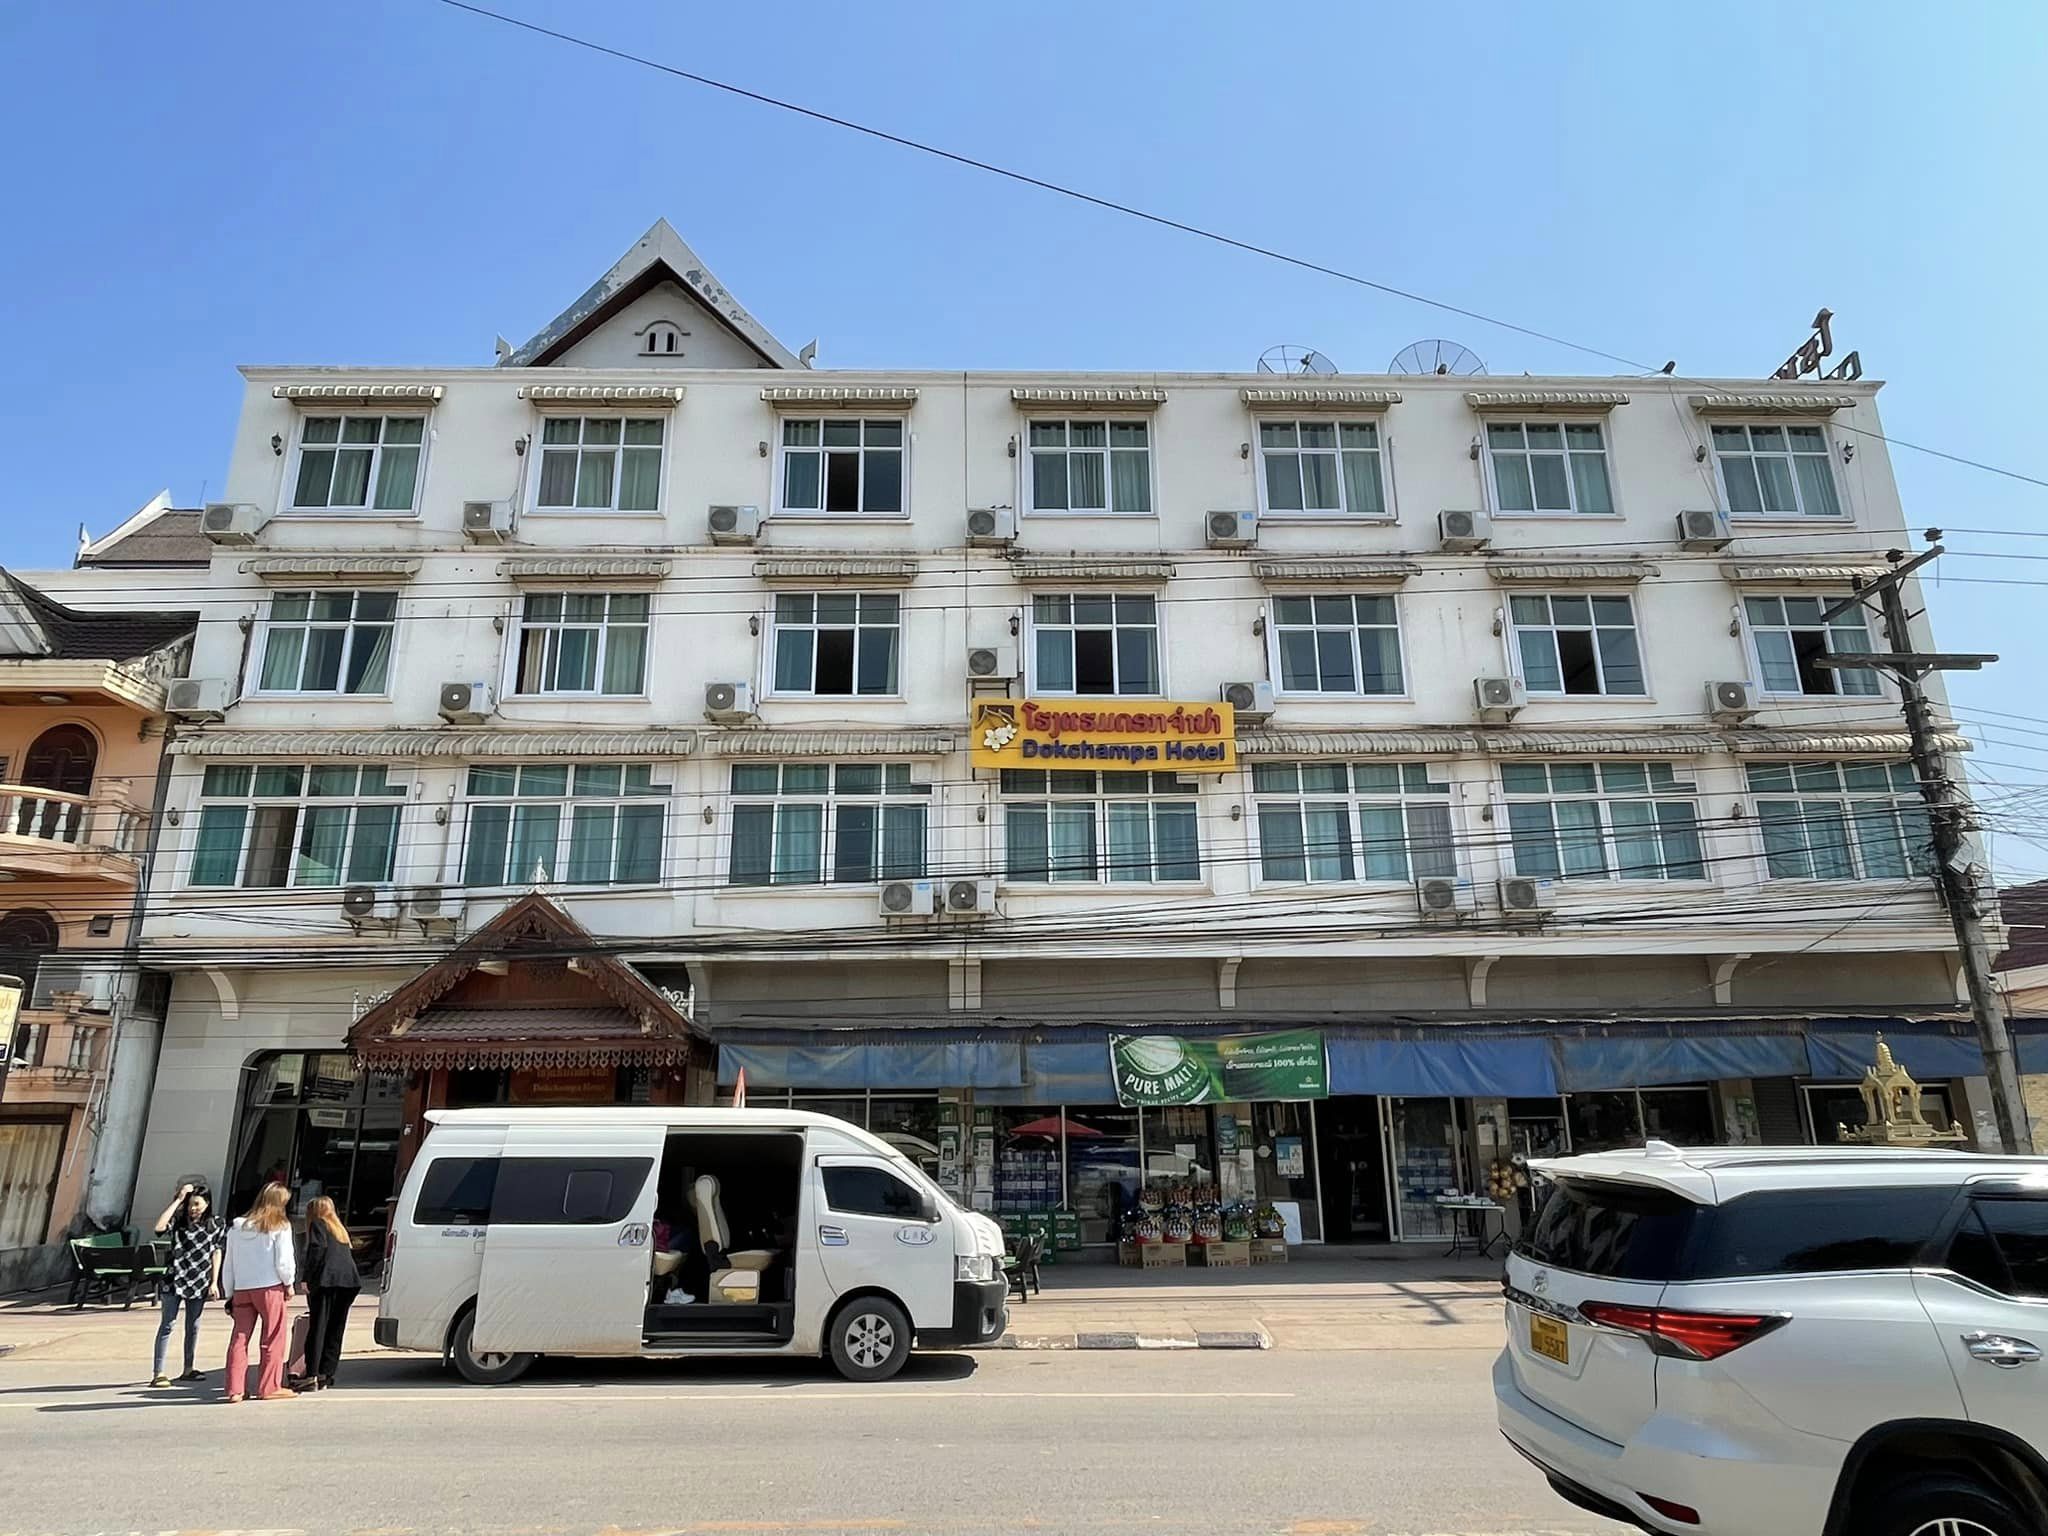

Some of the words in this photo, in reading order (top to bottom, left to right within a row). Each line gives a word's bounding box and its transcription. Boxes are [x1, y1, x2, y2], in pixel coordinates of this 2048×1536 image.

[1022, 739, 1158, 764] Dokchampa
[1165, 741, 1225, 761] Hotel
[1273, 1059, 1295, 1068] 100%
[1124, 1073, 1160, 1095] PURE
[1164, 1066, 1193, 1092] MALT
